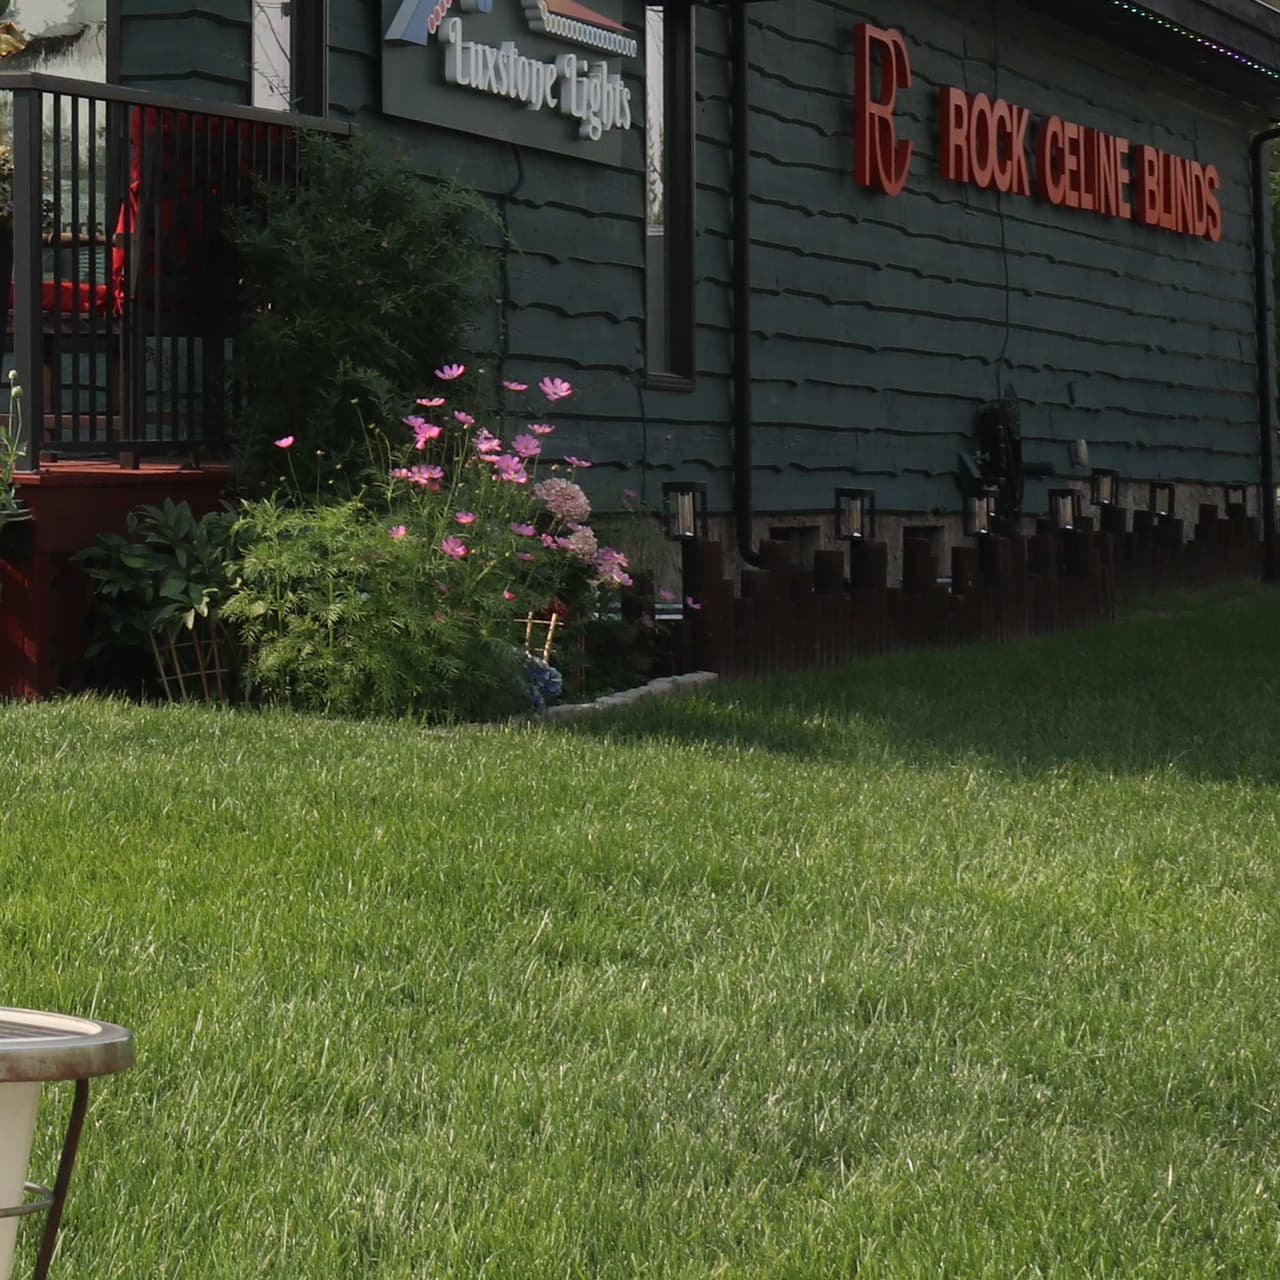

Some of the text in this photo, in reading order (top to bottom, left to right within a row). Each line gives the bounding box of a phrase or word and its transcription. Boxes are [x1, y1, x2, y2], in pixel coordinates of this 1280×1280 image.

[439, 16, 632, 141] Luxstone Lights
[941, 86, 1222, 242] ROCK CELINE BLINDS
